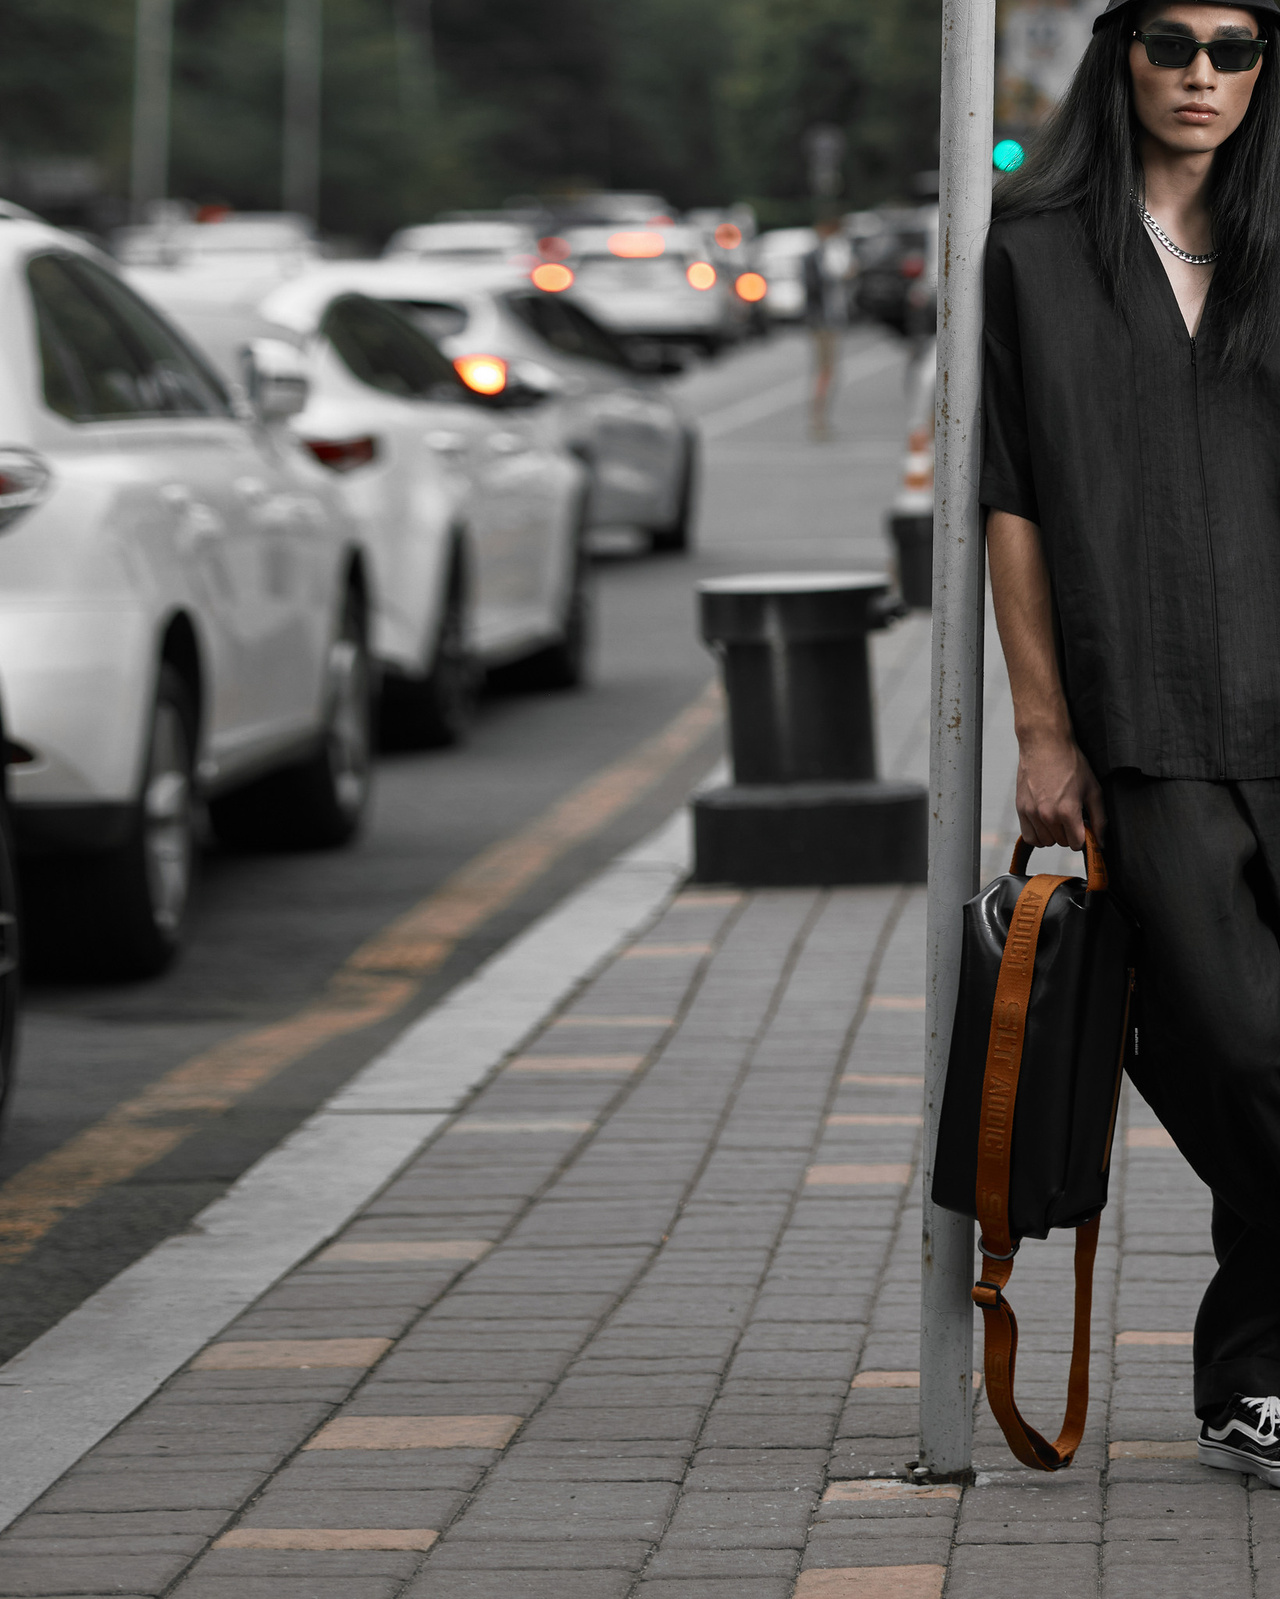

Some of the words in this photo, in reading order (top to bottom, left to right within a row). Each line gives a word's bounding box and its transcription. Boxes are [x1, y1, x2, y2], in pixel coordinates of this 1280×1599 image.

[1007, 890, 1043, 976] ADDICT
[993, 999, 1021, 1069] SLT
[983, 1073, 1011, 1165] ADDICT
